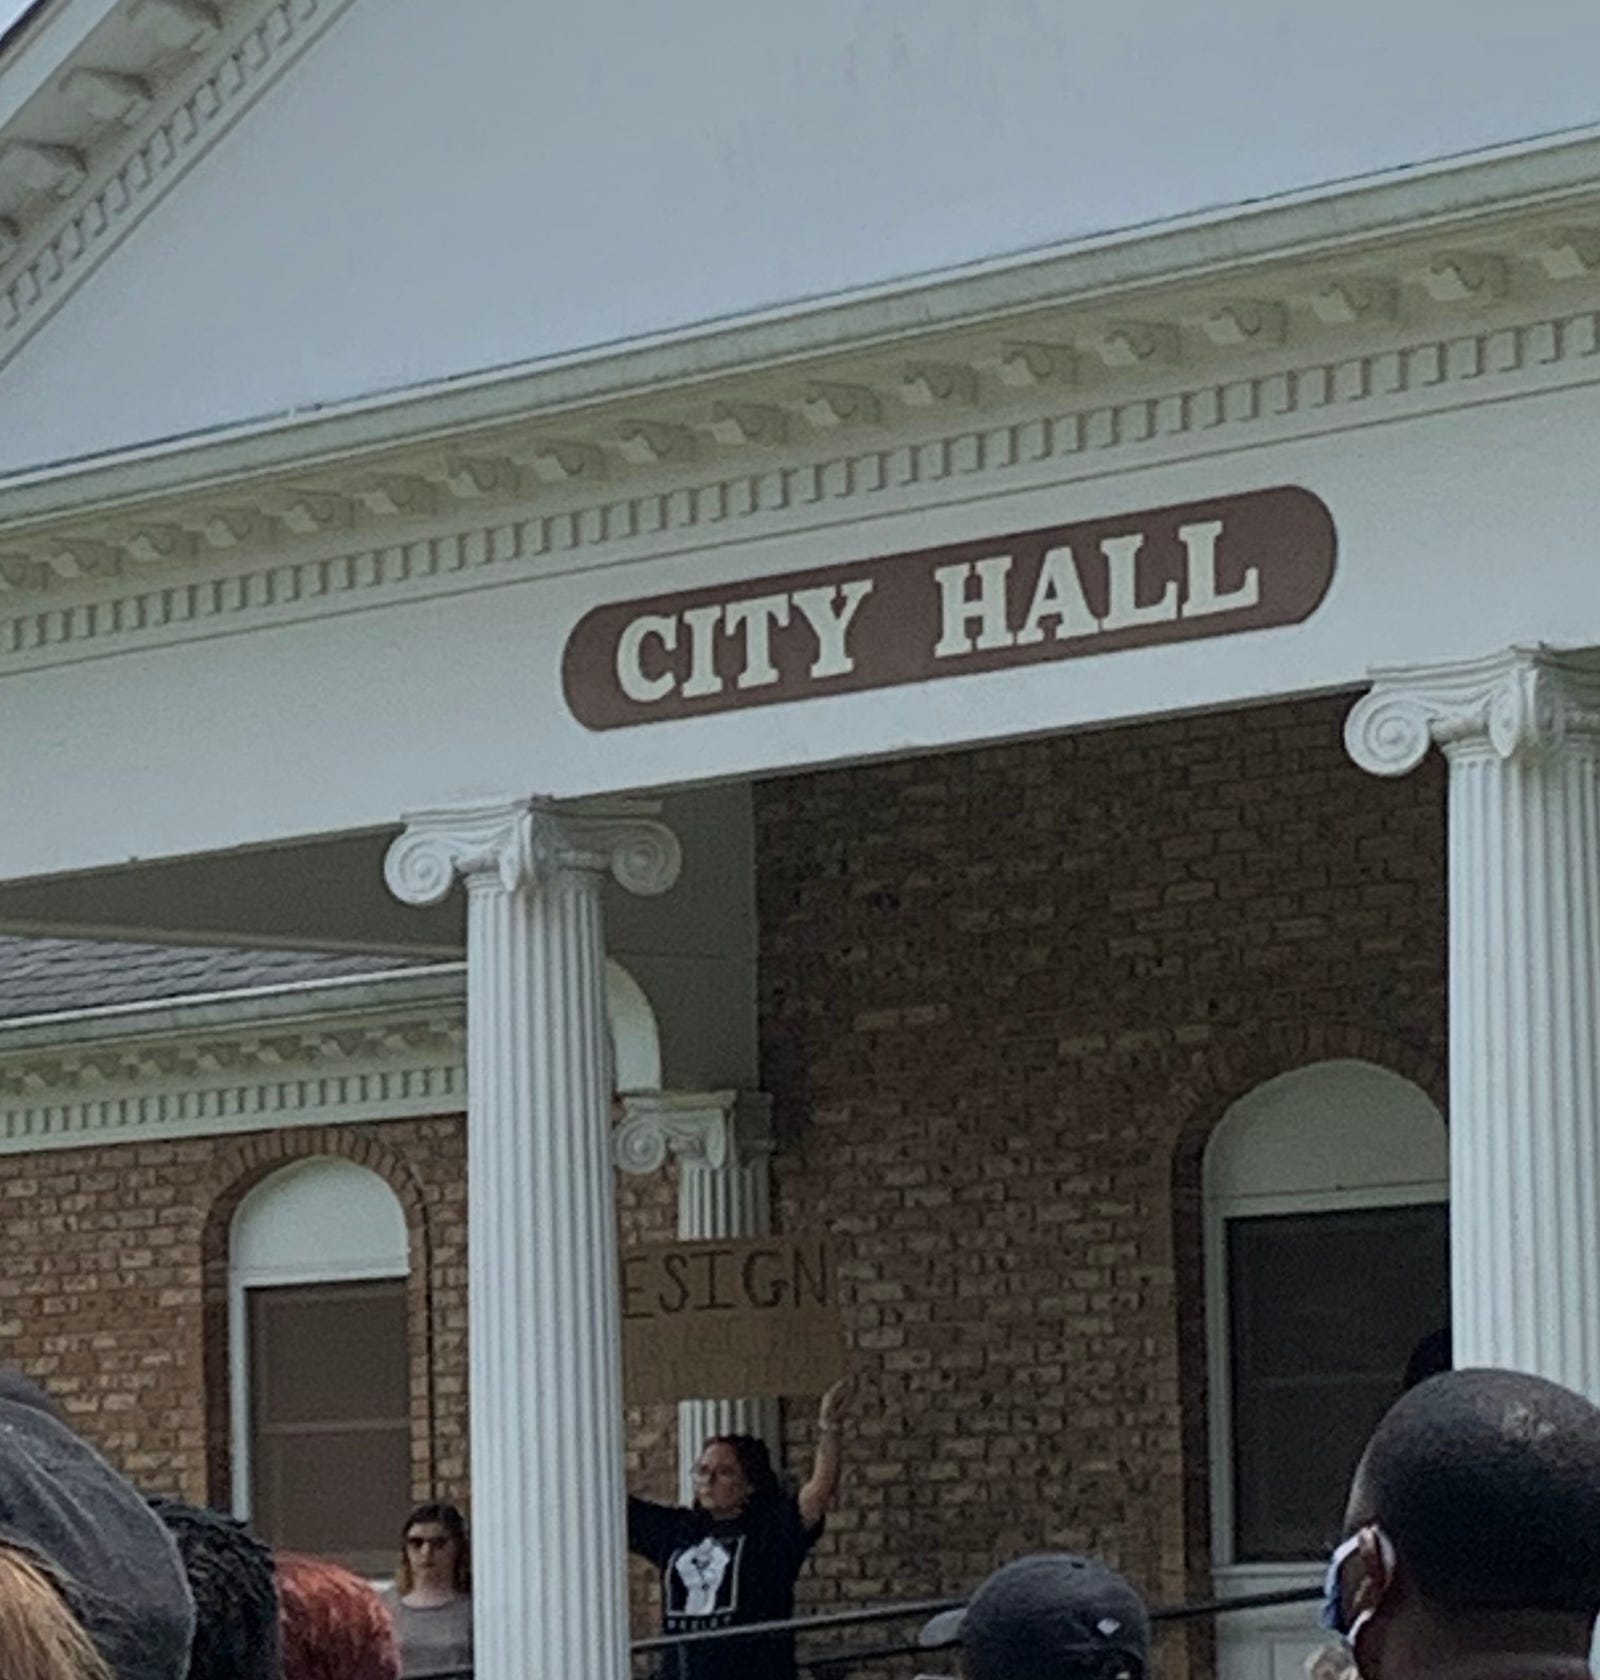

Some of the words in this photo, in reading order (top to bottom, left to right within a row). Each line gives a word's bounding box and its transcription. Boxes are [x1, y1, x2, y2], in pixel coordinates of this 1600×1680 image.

[615, 580, 874, 703] CITY
[934, 521, 1259, 657] HALL
[622, 1244, 827, 1320] ESIGN
